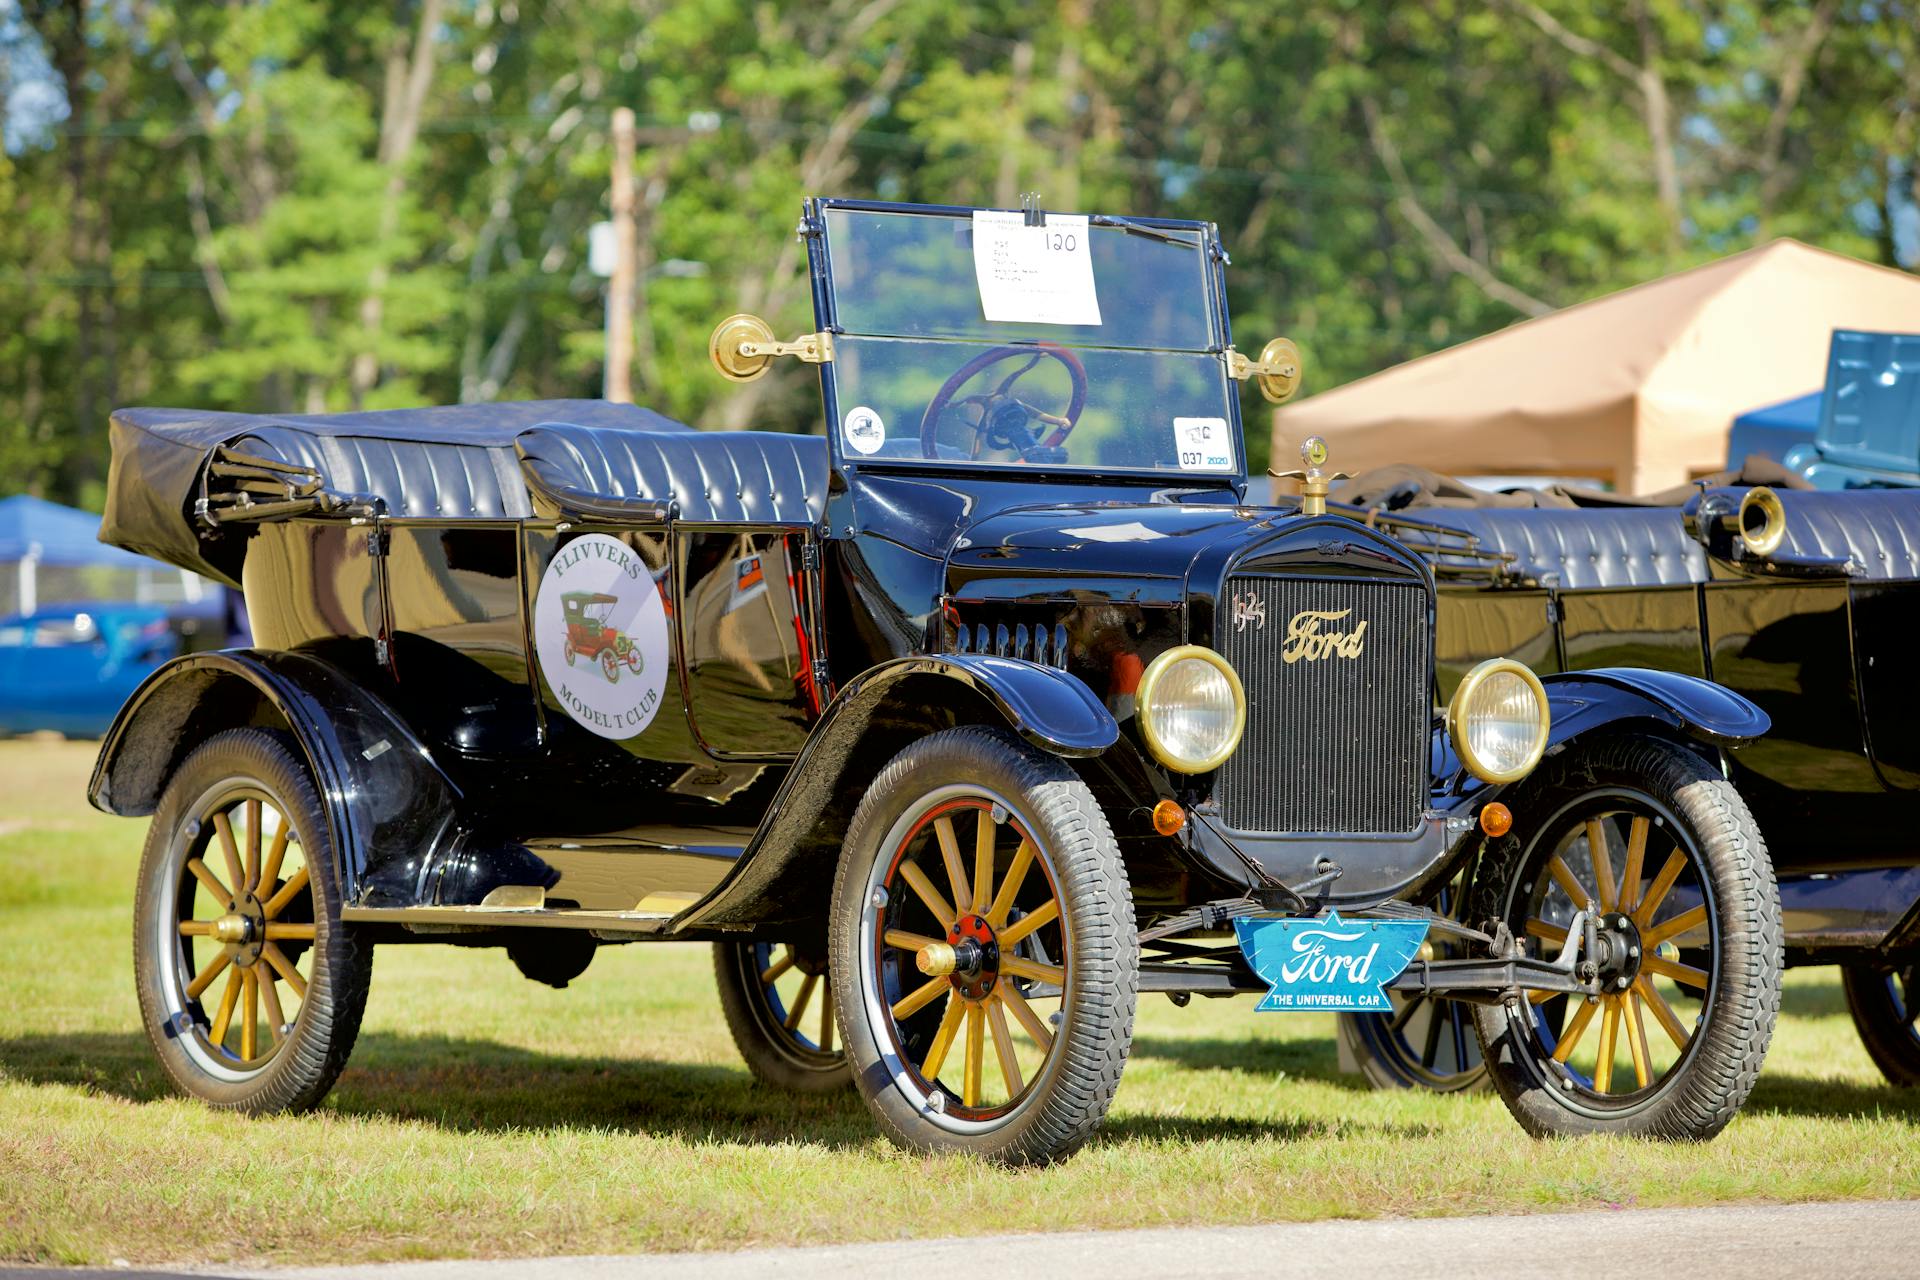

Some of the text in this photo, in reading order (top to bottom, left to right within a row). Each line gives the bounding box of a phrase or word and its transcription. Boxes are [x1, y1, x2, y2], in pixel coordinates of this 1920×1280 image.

[1046, 233, 1076, 252] 120
[1183, 452, 1228, 465] 037 2020
[552, 541, 641, 581] FLIVVERS
[1283, 608, 1368, 664] Ford
[559, 683, 657, 729] MODEL T CLUB
[1281, 930, 1380, 985] Ford
[1272, 994, 1380, 1006] THE UNIVERSAL CAR
